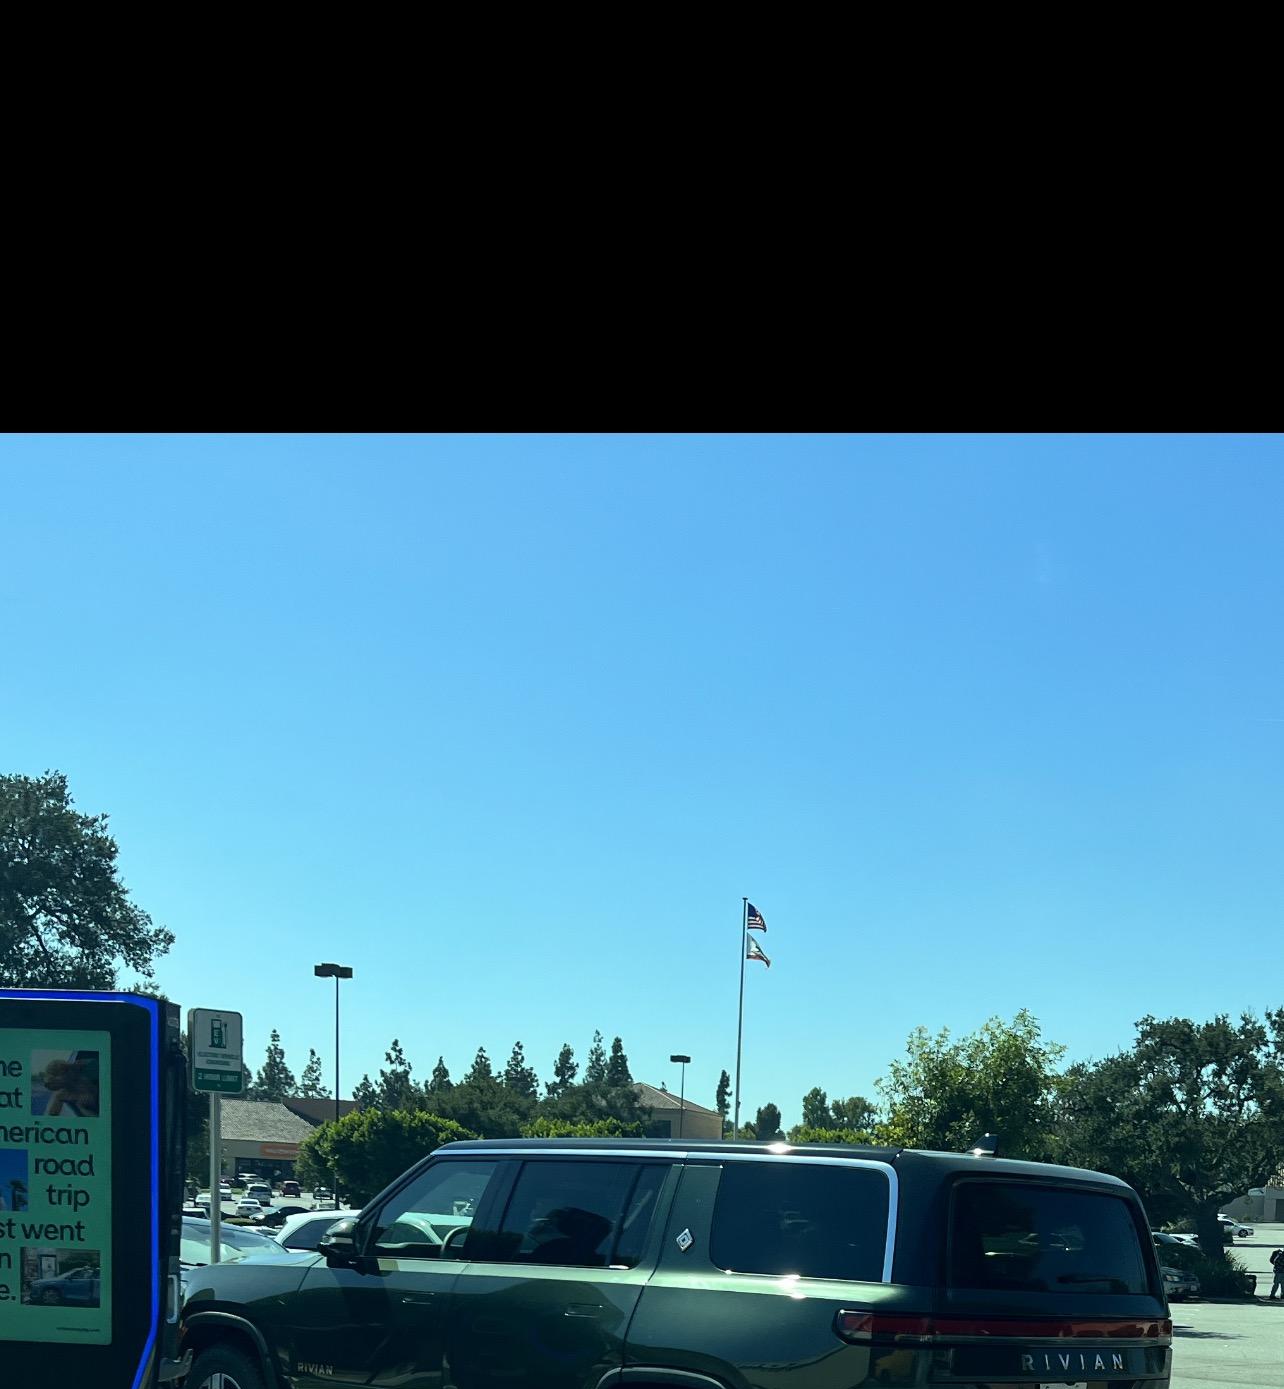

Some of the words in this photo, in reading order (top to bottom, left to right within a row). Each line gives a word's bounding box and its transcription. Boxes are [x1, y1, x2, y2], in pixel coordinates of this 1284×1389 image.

[34, 1153, 95, 1177] road
[46, 1183, 90, 1212] trip
[21, 1220, 85, 1242] went
[297, 1362, 334, 1376] RIVIAN
[1021, 1353, 1124, 1371] RIVIAN
